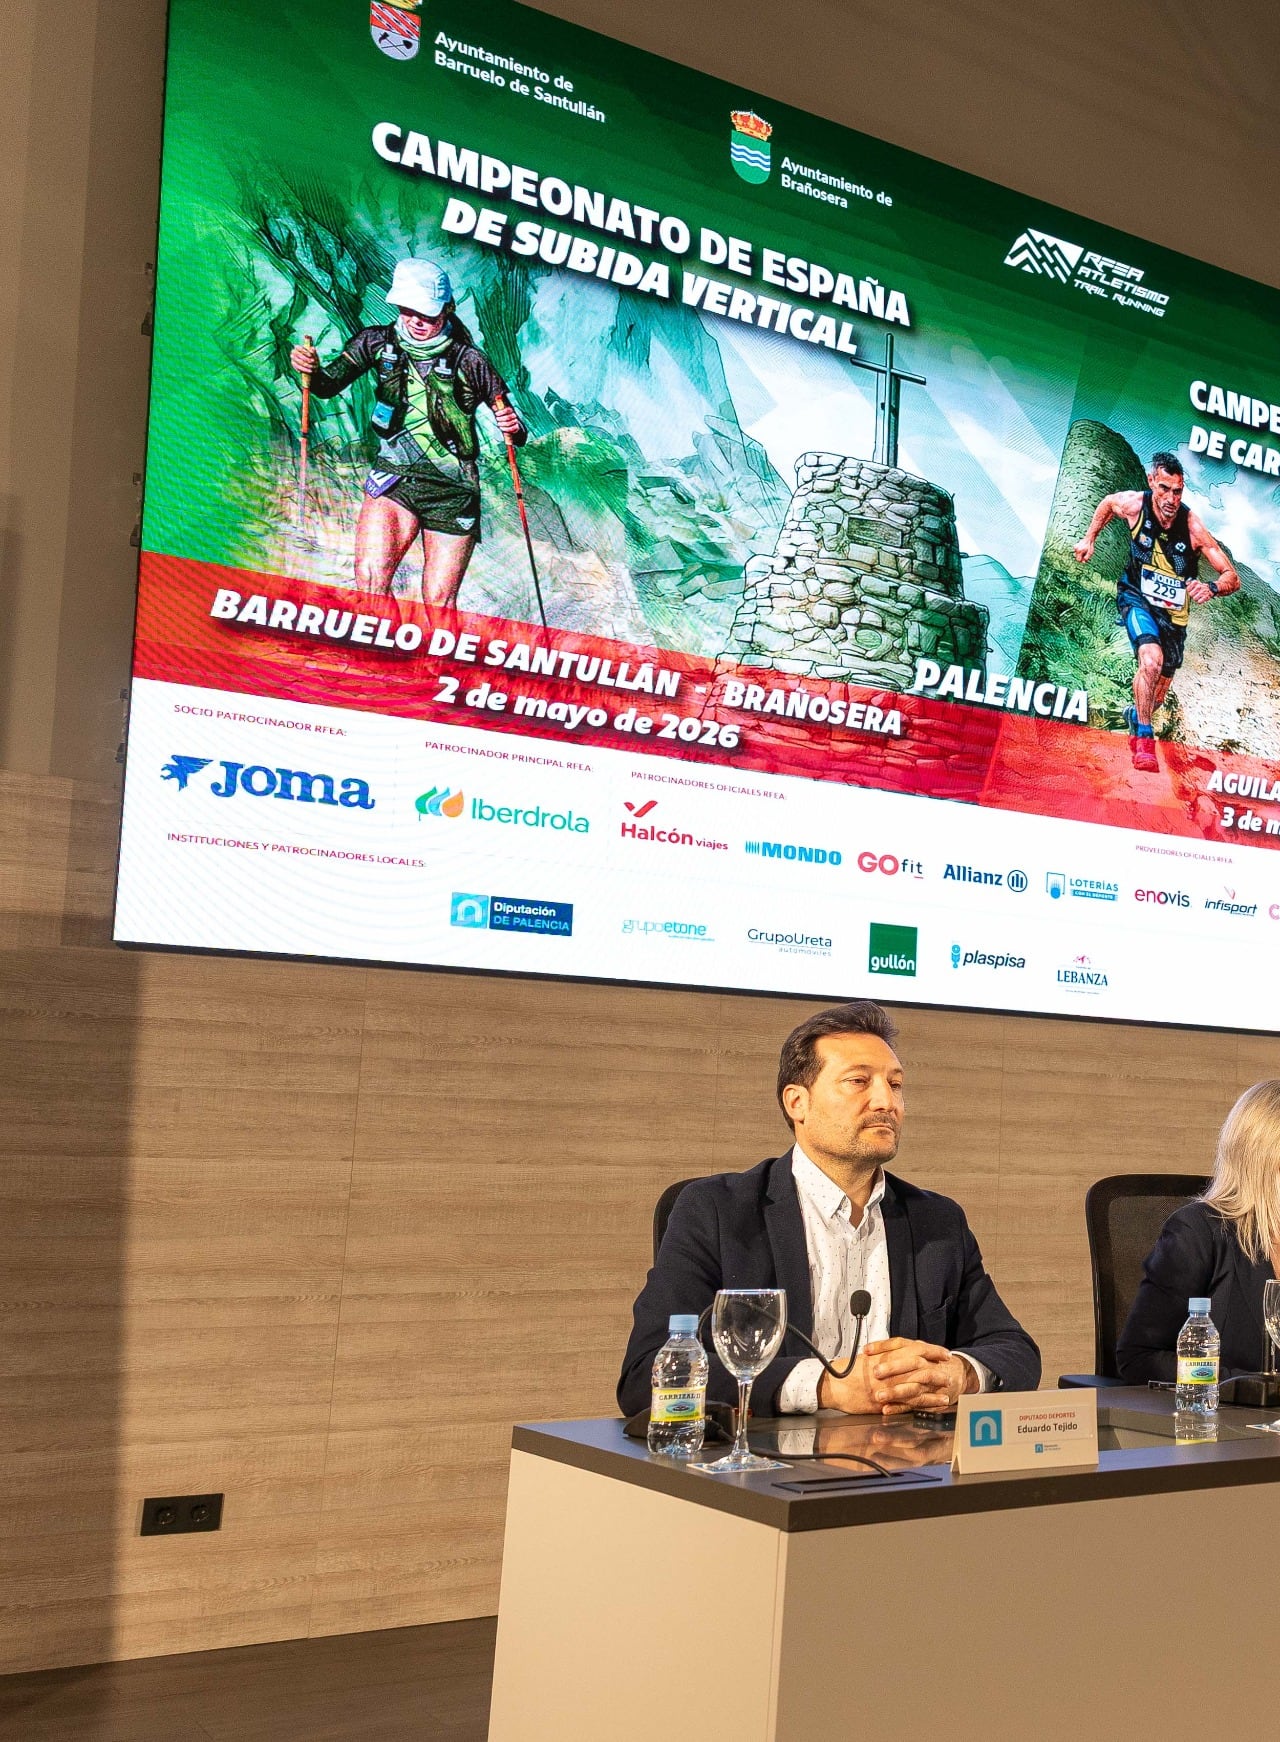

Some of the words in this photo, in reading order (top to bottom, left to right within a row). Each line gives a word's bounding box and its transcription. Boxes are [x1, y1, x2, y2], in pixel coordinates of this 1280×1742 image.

[434, 32, 549, 87] Ayuntamiento
[553, 75, 574, 92] de
[434, 50, 505, 87] Barruelo
[510, 77, 530, 95] de
[533, 87, 606, 123] Santullán
[781, 156, 874, 201] Ayuntamiento
[877, 190, 893, 207] de
[781, 174, 849, 209] Brañosera
[371, 122, 690, 254] CAMPEONATO
[699, 227, 753, 276] DE
[761, 249, 911, 327] ESPAÑA
[441, 198, 507, 247] DE
[510, 223, 670, 299] SUBIDA
[681, 273, 858, 355] VERTICAL
[1083, 251, 1144, 282] RFEA
[1073, 278, 1109, 299] TRAIL
[1112, 292, 1166, 318] RUNNING
[1077, 265, 1170, 306] ATLETISMO
[1188, 425, 1226, 461] DE
[1153, 582, 1176, 599] 229
[209, 588, 423, 651] BARRUELO
[428, 628, 477, 663] DE
[484, 638, 682, 698] SANTULLÁN
[723, 680, 901, 735] BRAÑOSERA
[912, 659, 1089, 723] PALENCIA
[173, 703, 214, 718] SOCIO
[216, 709, 313, 731] PATROCINADOR
[431, 677, 457, 703] 2
[465, 682, 509, 716] de
[513, 696, 608, 736] mayo
[613, 705, 654, 735] de
[656, 716, 741, 749] 2026
[425, 741, 508, 760] PATROCINADOR
[511, 752, 564, 769] PRINCIPAL
[631, 770, 715, 790] PATROCINADORES
[716, 783, 760, 798] OFICIALES
[470, 796, 591, 835] Iberdrola
[1220, 806, 1234, 827] 3
[1237, 809, 1262, 832] de
[167, 833, 259, 851] INSTITUCIONES
[261, 842, 269, 851] Y
[271, 844, 374, 864] PATROCINADORES
[620, 821, 693, 849] Halcón
[695, 837, 729, 851] viajes
[761, 841, 842, 866] MONDO
[943, 863, 1003, 888] Allianz
[1070, 878, 1119, 892] LOTERÍAS
[493, 902, 556, 918] Diputación
[1134, 888, 1190, 907] enovis
[1205, 899, 1257, 914] infisport
[494, 915, 510, 928] DE
[512, 917, 570, 933] PALENCIA
[748, 928, 832, 947] GrupoUreta
[871, 953, 915, 972] gullón
[963, 949, 1026, 970] plaspisa
[1057, 970, 1108, 986] LEBANZA
[1018, 1425, 1051, 1434] Eduardo
[1053, 1422, 1078, 1432] Tejido
